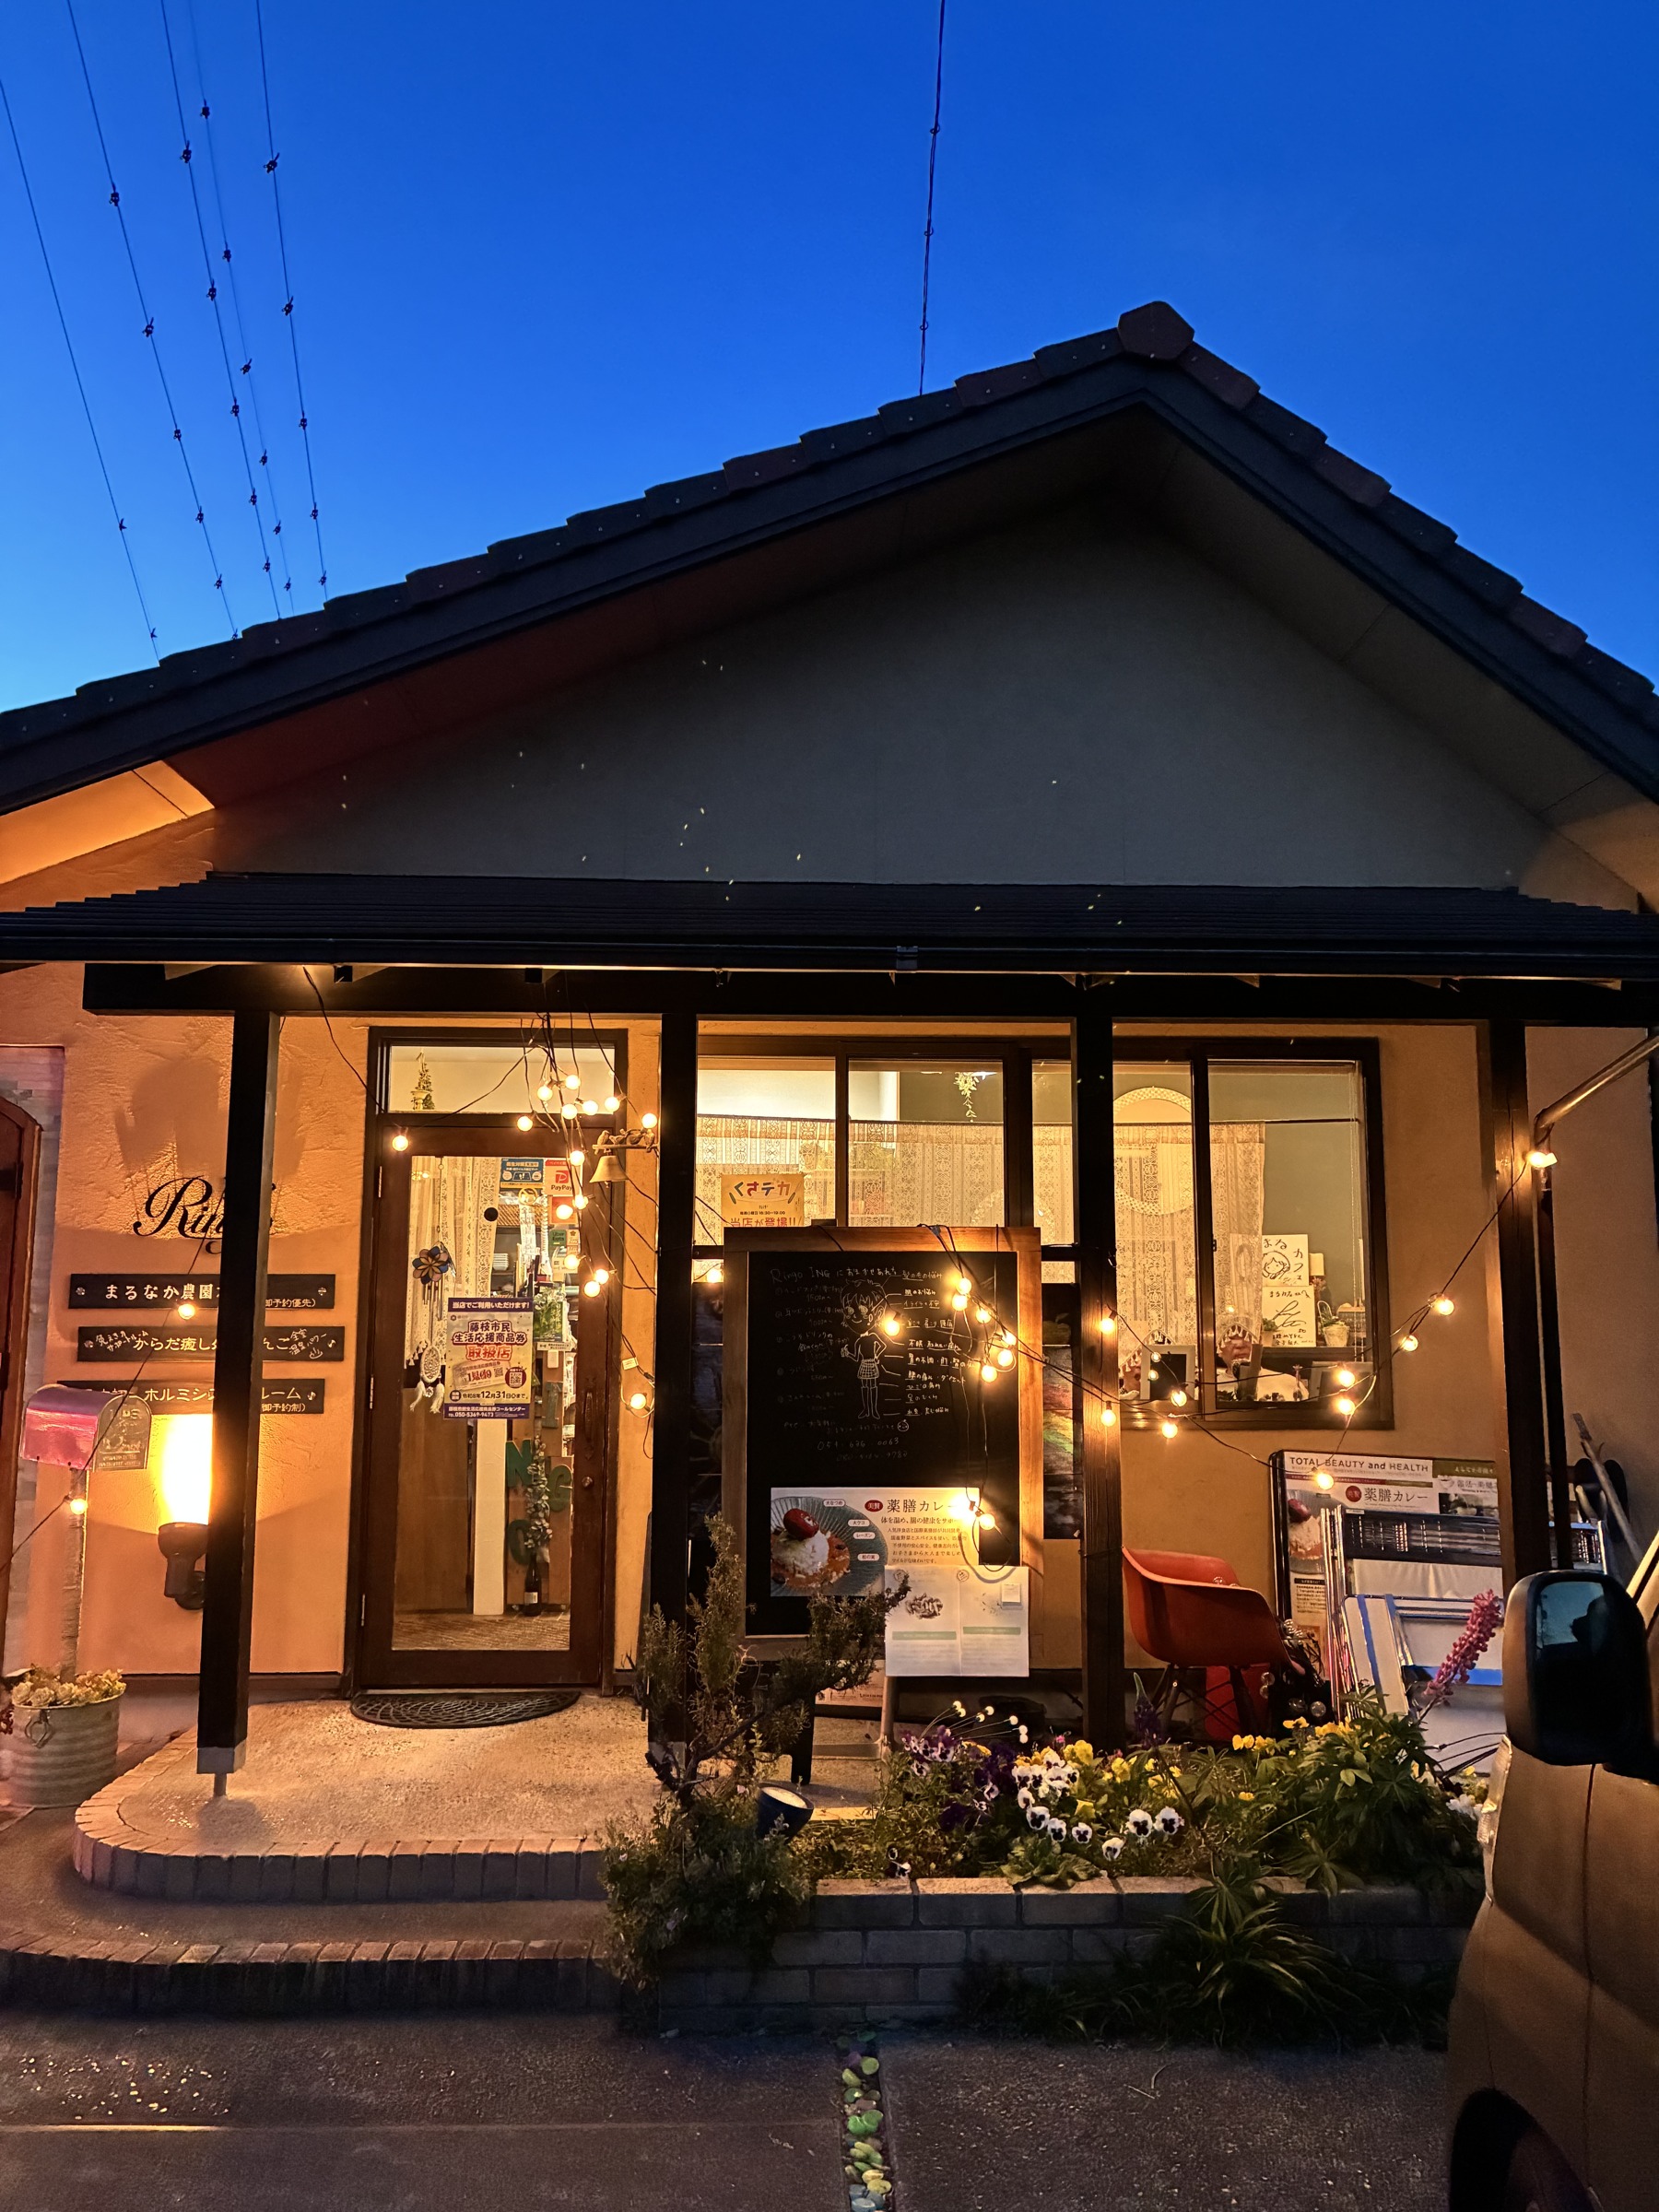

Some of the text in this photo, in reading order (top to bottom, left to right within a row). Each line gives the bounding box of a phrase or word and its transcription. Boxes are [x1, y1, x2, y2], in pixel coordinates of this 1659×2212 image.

[734, 1181, 790, 1196] くさデカ
[105, 1283, 220, 1300] まるなか農園
[468, 1321, 512, 1333] 藤枝市民
[453, 1333, 527, 1343] 生活応援商品券
[467, 1346, 512, 1359] 取扱店
[1289, 1456, 1322, 1466] TOTAL
[1324, 1459, 1365, 1469] BEAUTY
[1368, 1462, 1386, 1470] and
[1389, 1463, 1429, 1472] HEALTH
[1364, 1487, 1429, 1503] 薬膳カレー
